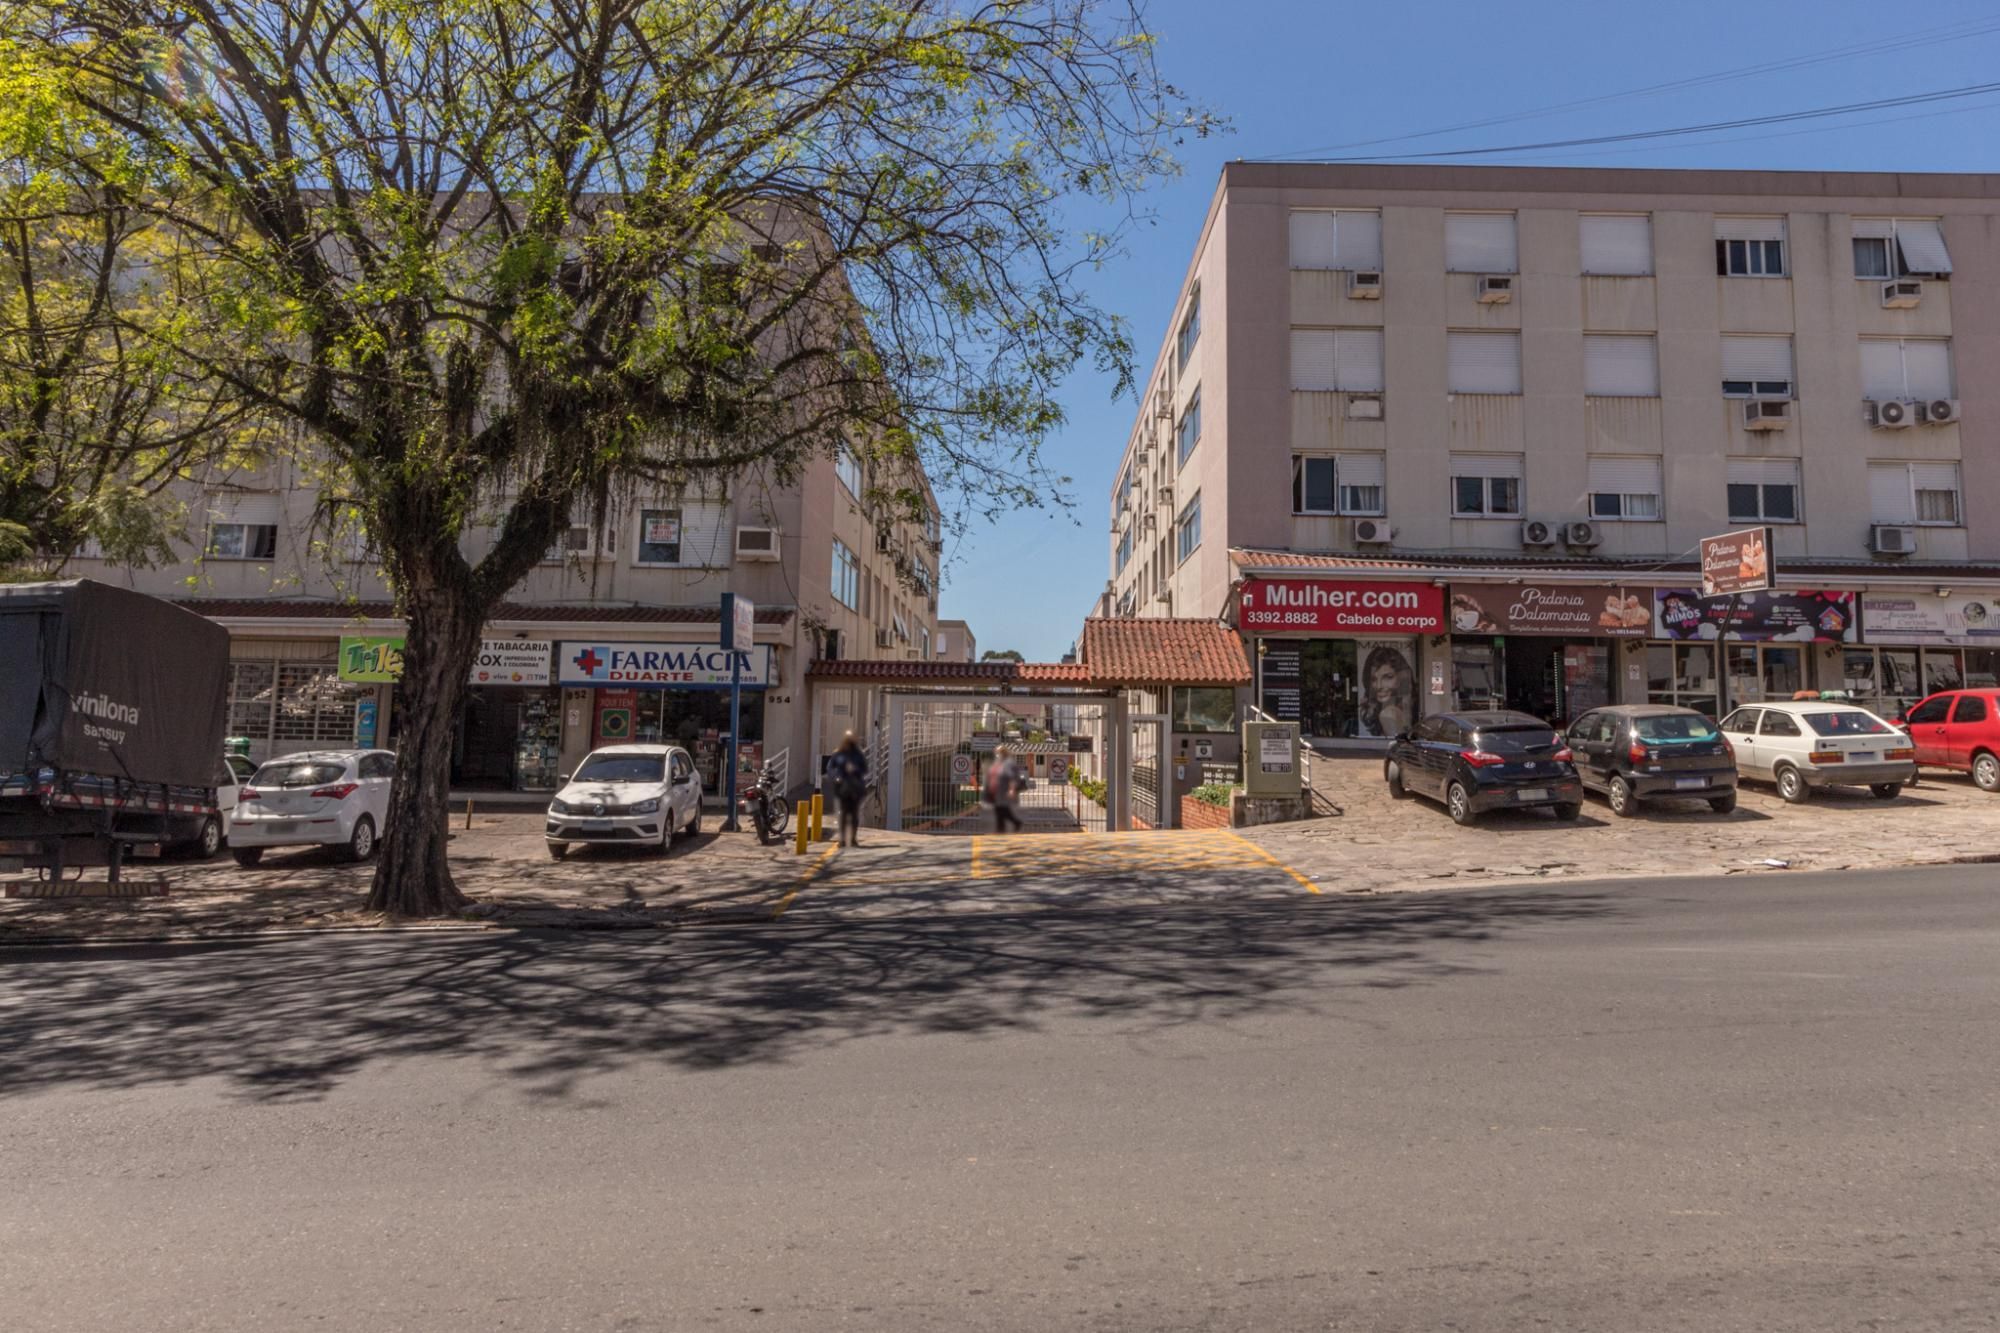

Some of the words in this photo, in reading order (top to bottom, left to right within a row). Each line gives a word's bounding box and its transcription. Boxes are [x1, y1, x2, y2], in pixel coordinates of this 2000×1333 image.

[1266, 585, 1418, 609] Mulher.com
[1520, 587, 1584, 606] Padaria
[1247, 611, 1318, 624] 3392.8882
[1336, 612, 1383, 625] Cabelo
[1386, 616, 1395, 625] e
[1397, 616, 1437, 629] corpo
[1508, 603, 1591, 622] Dalamaria
[1665, 608, 1701, 625] MIMOS
[493, 643, 549, 652] TABACARIA
[611, 645, 752, 671] FARMÁCIA
[609, 671, 693, 681] DUARTE
[70, 690, 139, 726] vinilona
[768, 695, 791, 704] 954
[83, 724, 126, 745] sansuy
